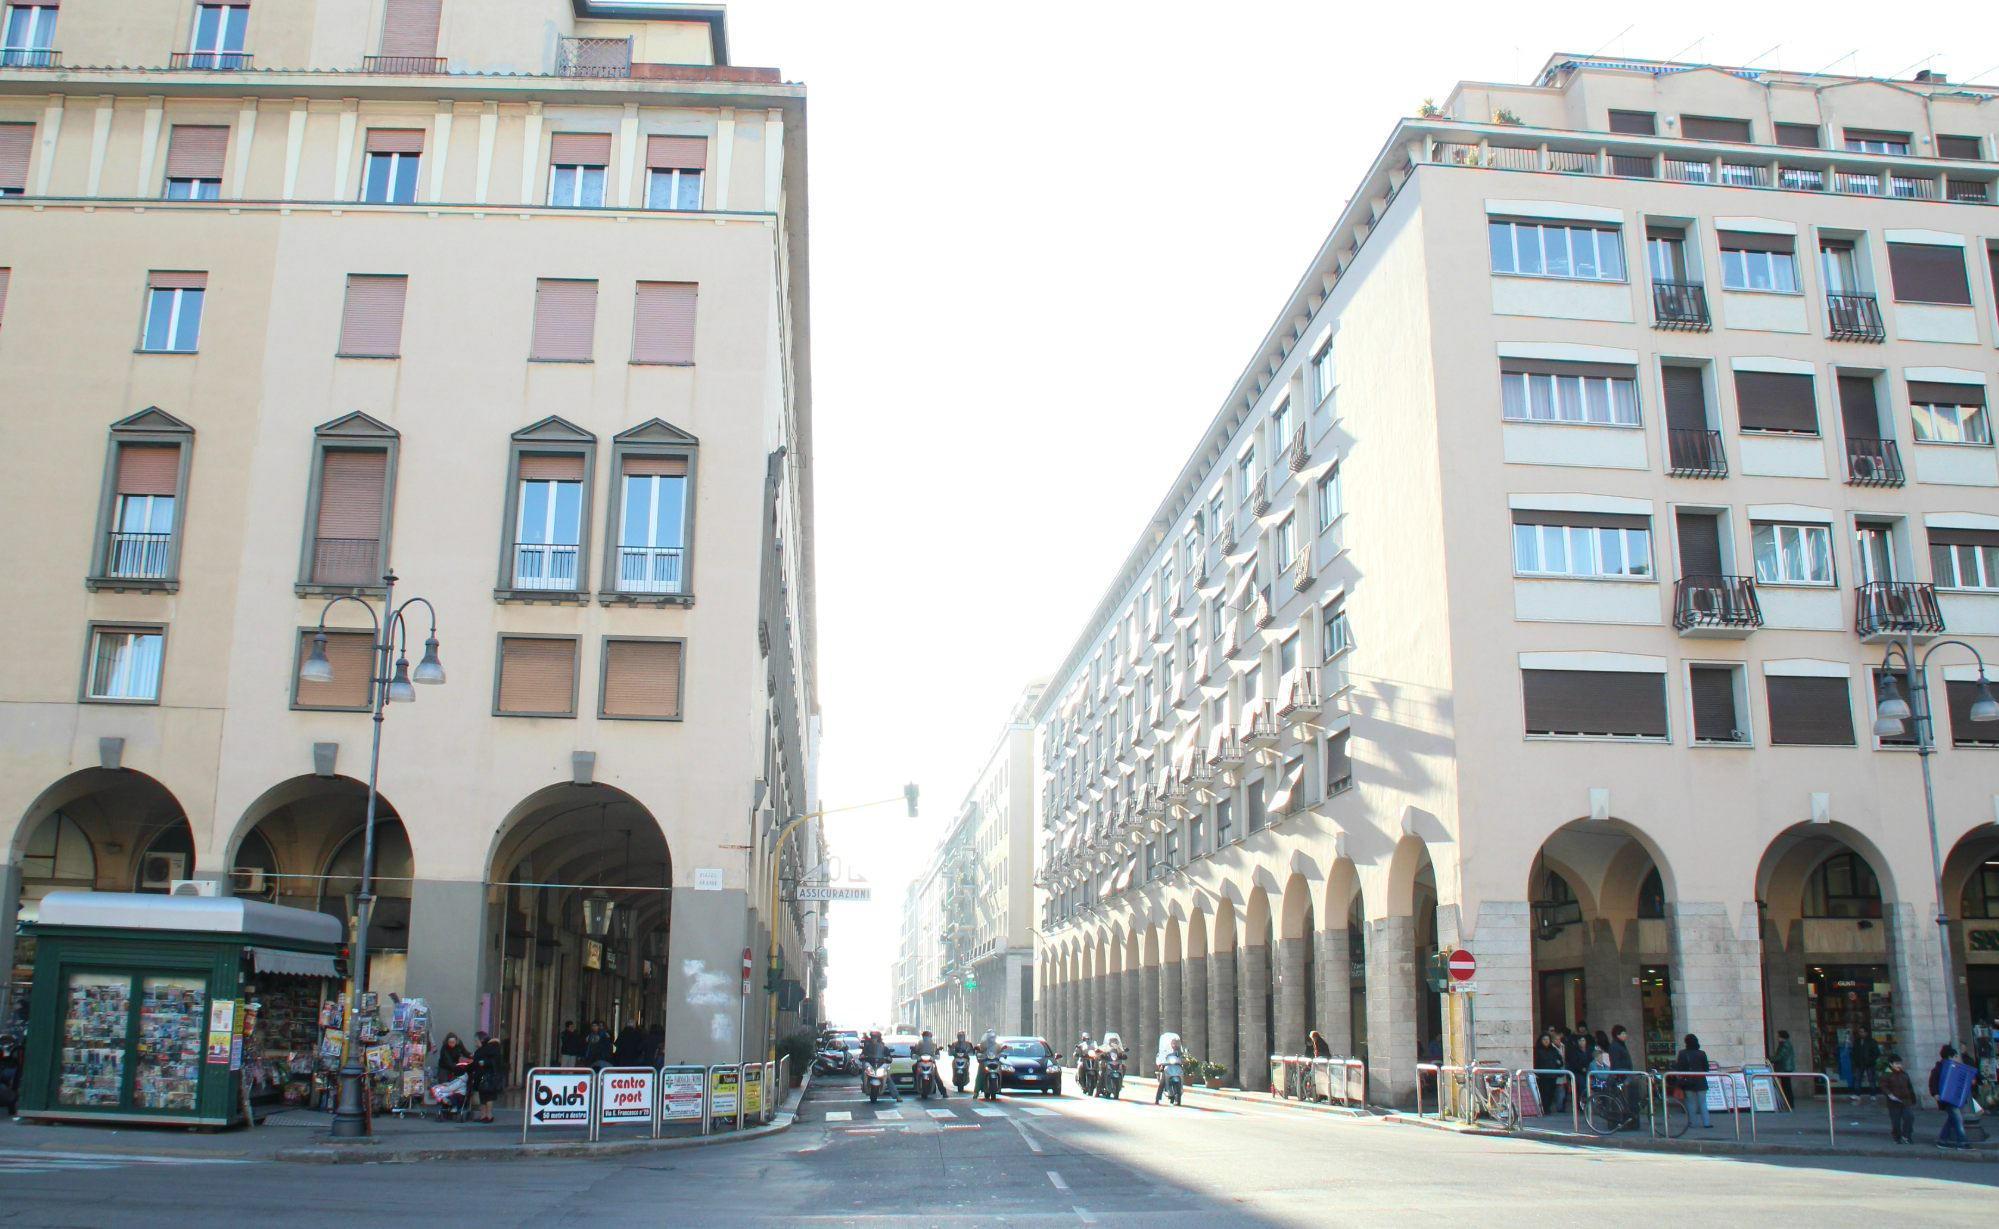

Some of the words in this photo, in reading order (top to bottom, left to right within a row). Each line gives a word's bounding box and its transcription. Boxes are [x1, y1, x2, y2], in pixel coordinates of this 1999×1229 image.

[800, 888, 870, 899] ASSICURAZIONI
[611, 1076, 646, 1089] centro
[613, 1091, 642, 1106] sport
[570, 1111, 587, 1119] destra
